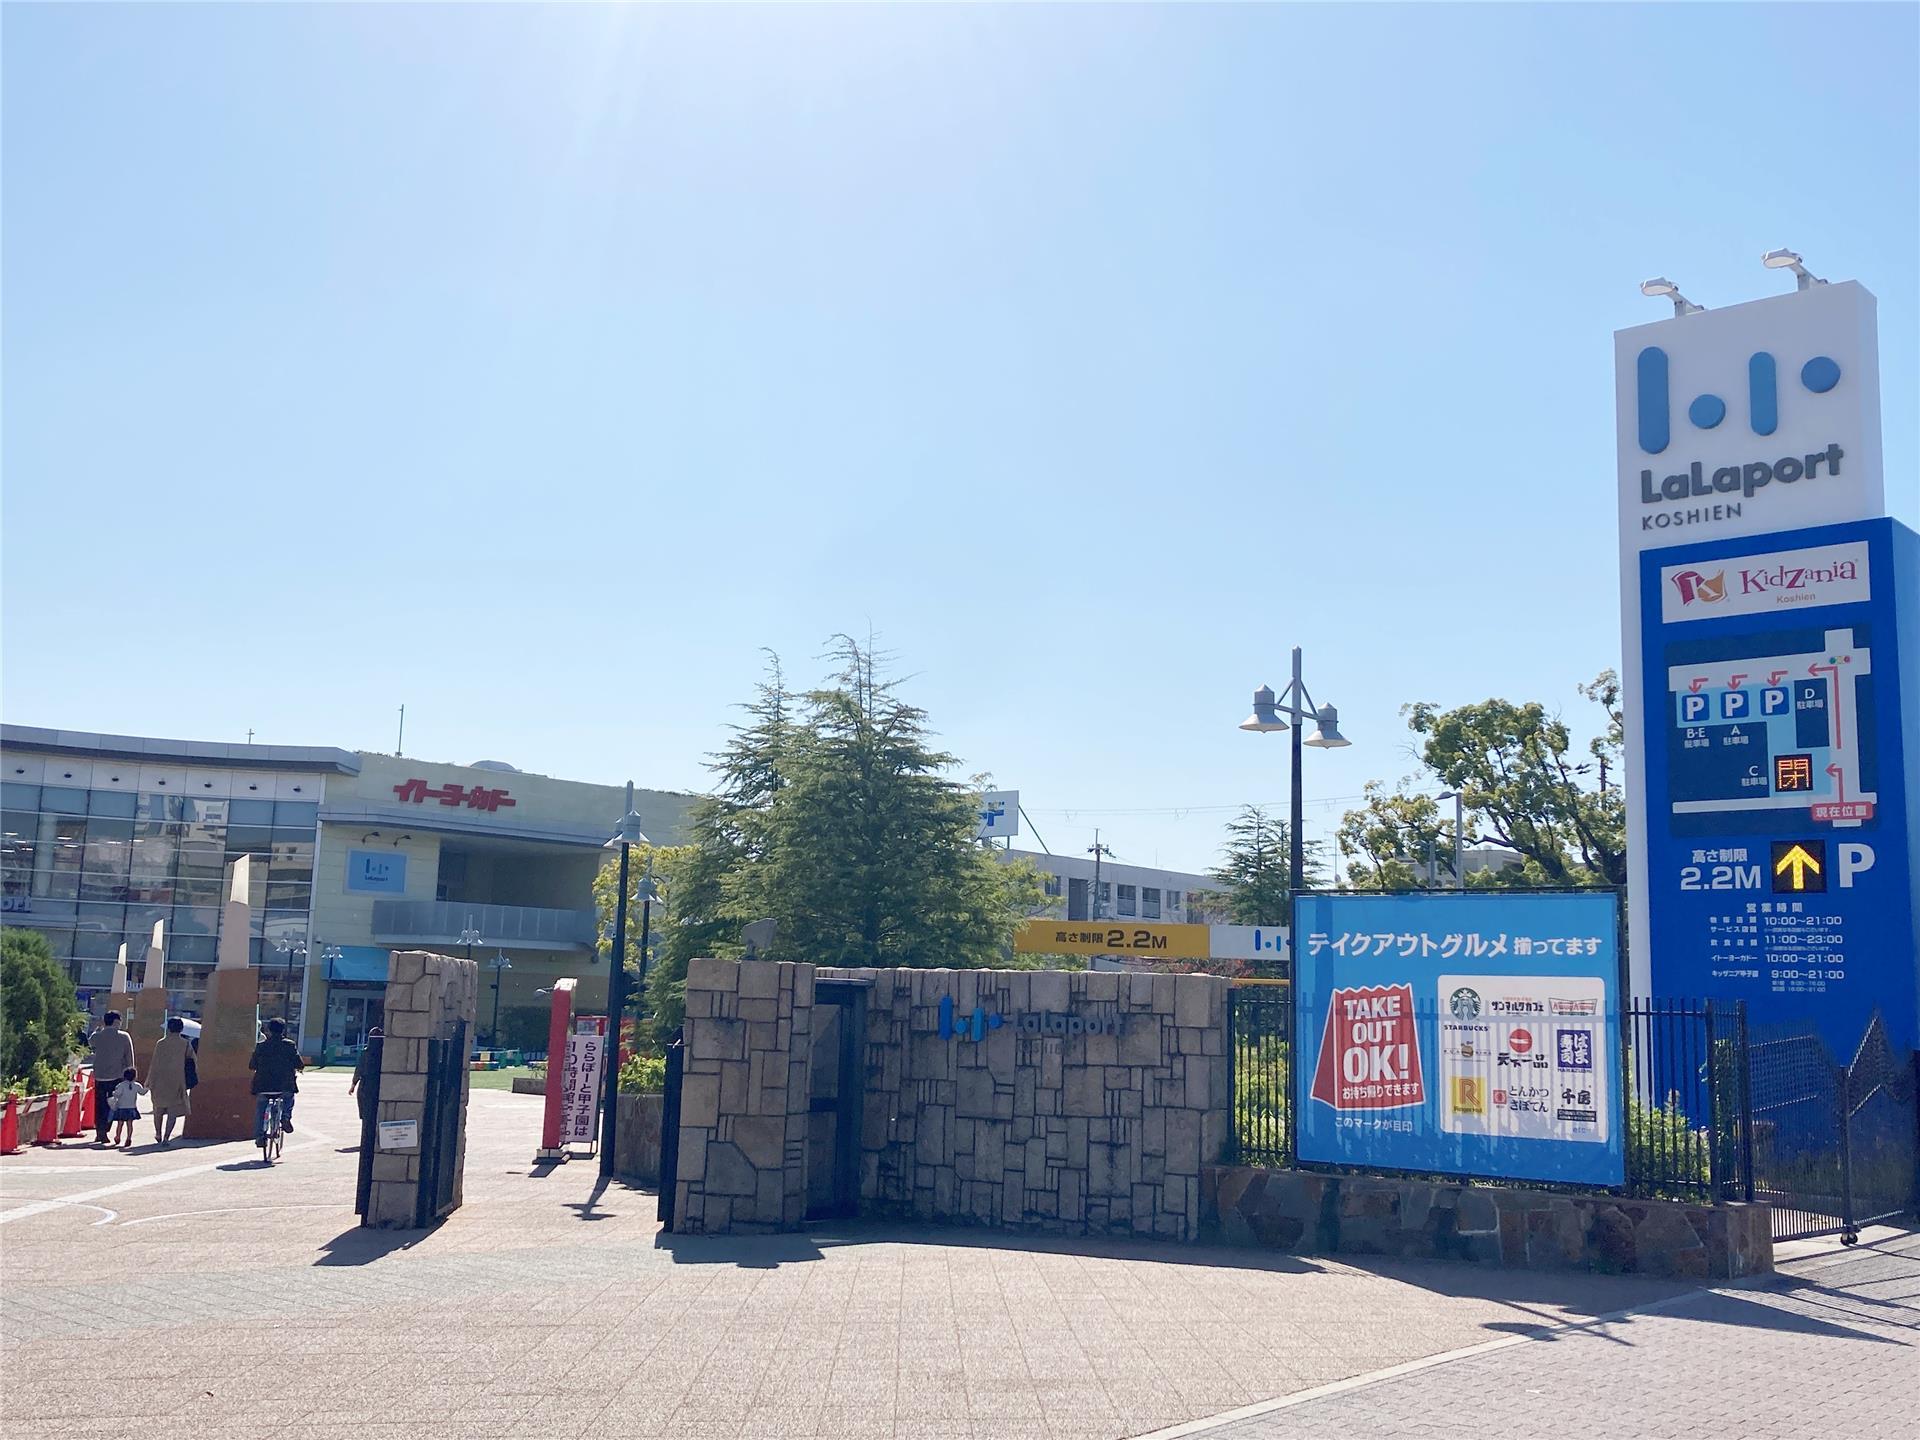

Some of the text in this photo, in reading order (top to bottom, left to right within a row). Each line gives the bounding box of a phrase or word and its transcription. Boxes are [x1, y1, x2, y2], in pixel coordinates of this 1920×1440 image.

[1640, 443, 1844, 503] LaLaport
[1642, 503, 1742, 530] KOSHIEN
[1738, 560, 1857, 595] KidZania
[1776, 592, 1816, 604] Koshien
[1764, 690, 1784, 714] P
[1804, 688, 1815, 699] D
[1686, 697, 1705, 720] P
[1725, 693, 1744, 717] P
[1731, 725, 1741, 735] A
[1748, 765, 1759, 776] C
[1815, 805, 1867, 817] 現在位置
[1692, 848, 1748, 864] 高さ制限
[1838, 843, 1876, 888] P
[1680, 865, 1761, 891] 2.2M
[1055, 929, 1168, 950] 高さ制限 2.2M
[1308, 932, 1602, 958] テイクアウトグルメ 揃ってます
[1343, 995, 1401, 1020] TAKE
[1352, 1020, 1396, 1044] OUT
[1444, 1024, 1489, 1032] STARBUCKS
[1343, 1043, 1409, 1083] OK!
[1497, 1053, 1549, 1069] 天下一品
[574, 1041, 597, 1136] ららぽーと甲子園は
[1342, 1082, 1420, 1100] お持ち帰りできます
[1510, 1085, 1549, 1097] とんかつ
[1510, 1099, 1549, 1113] さぼてん
[1335, 1116, 1413, 1132] このマークが目印
